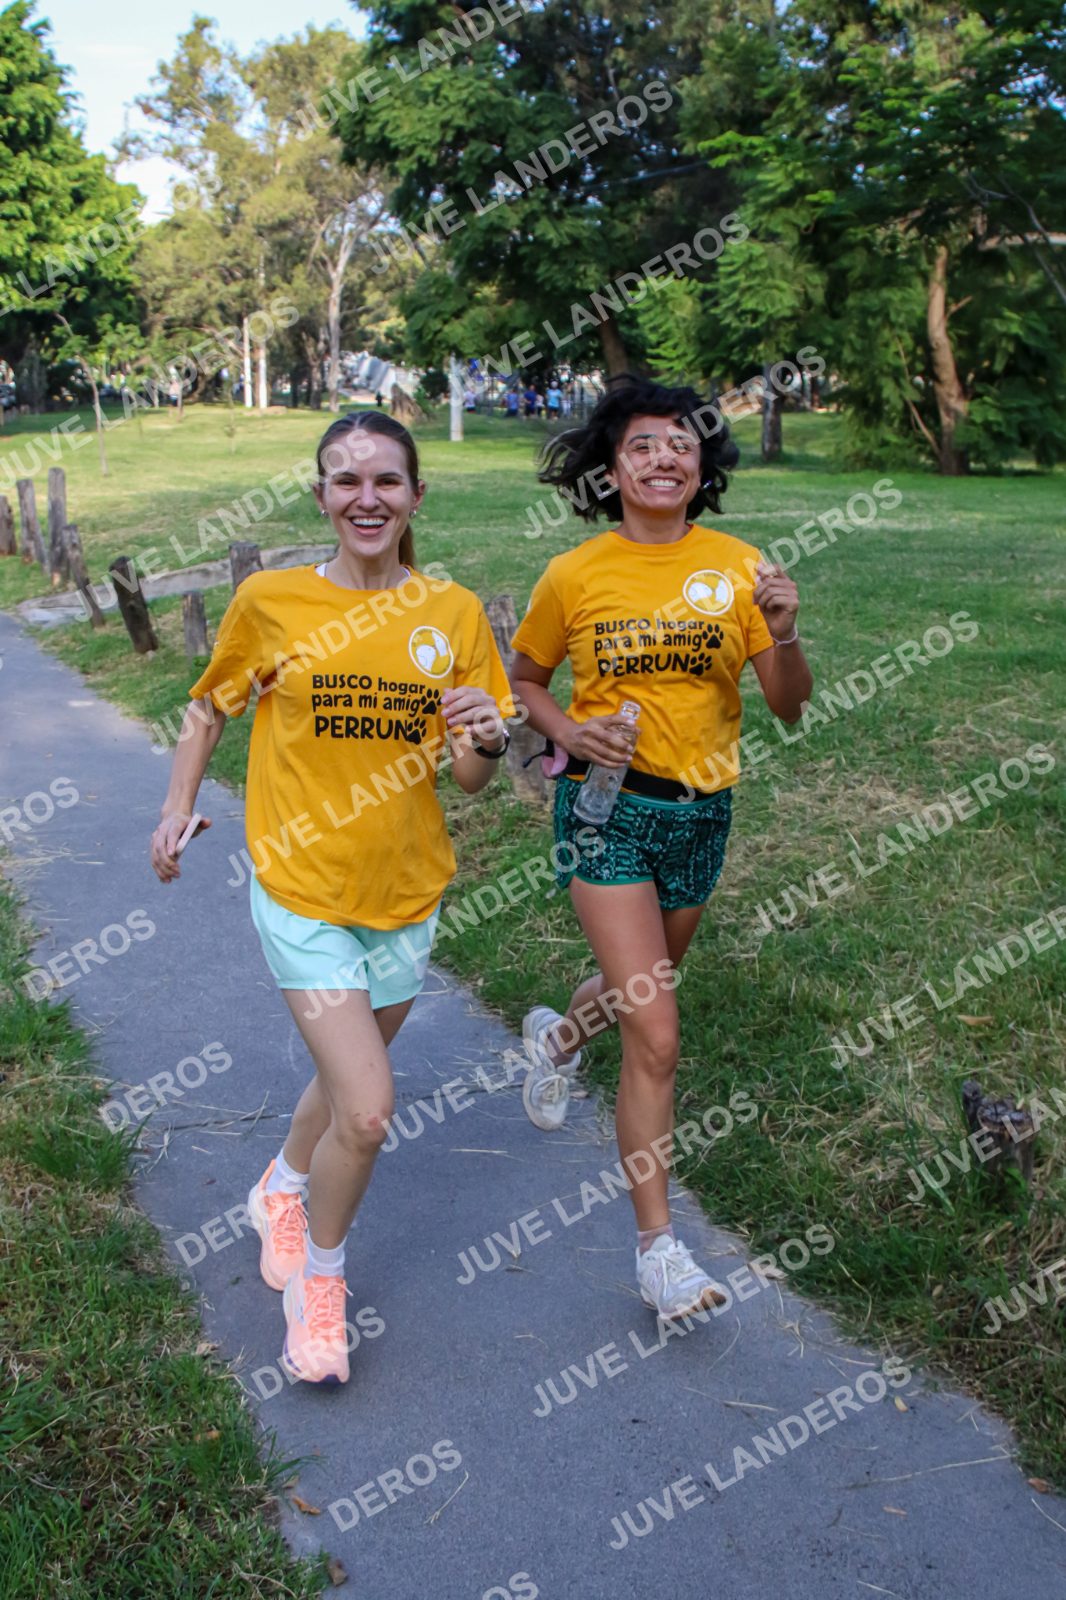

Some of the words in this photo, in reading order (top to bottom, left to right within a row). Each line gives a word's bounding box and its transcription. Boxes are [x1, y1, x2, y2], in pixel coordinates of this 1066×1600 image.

[595, 618, 650, 636] BUSCO
[656, 617, 704, 632] hogar
[594, 635, 632, 657] para
[638, 631, 656, 648] mi
[312, 673, 372, 690] BUSCO
[378, 676, 426, 695] hogar
[312, 693, 353, 712] para
[358, 692, 378, 709] mi
